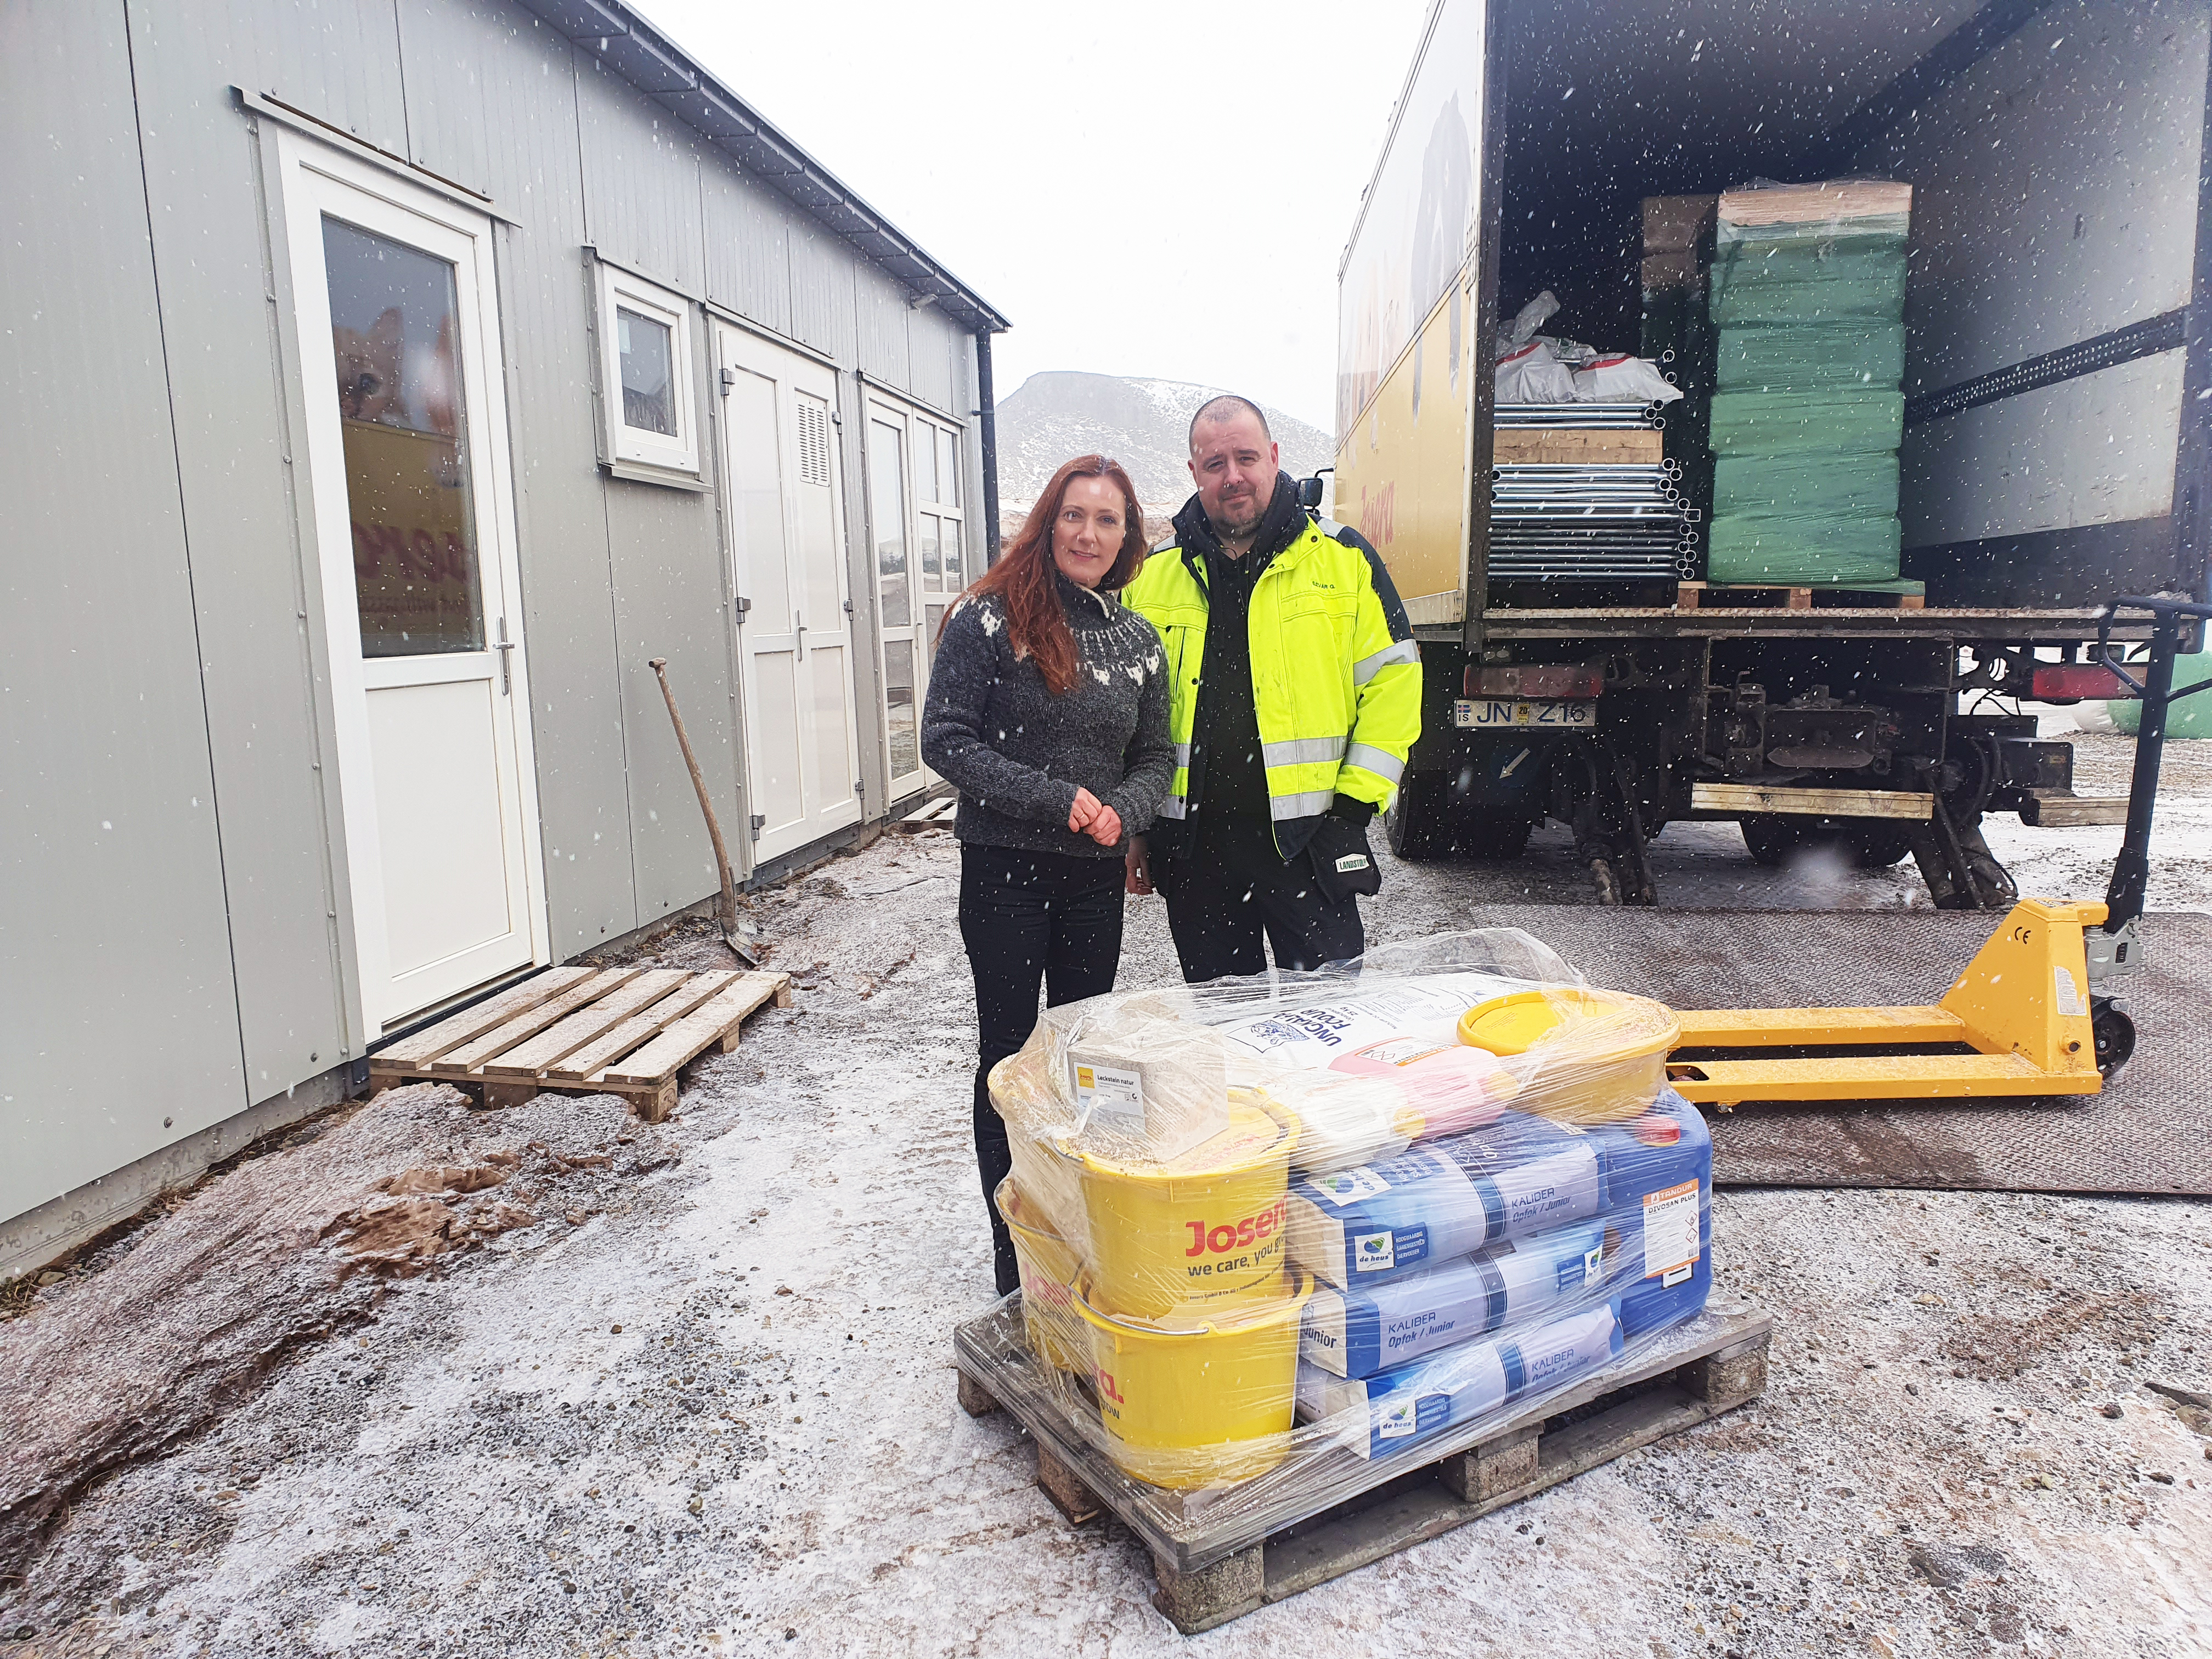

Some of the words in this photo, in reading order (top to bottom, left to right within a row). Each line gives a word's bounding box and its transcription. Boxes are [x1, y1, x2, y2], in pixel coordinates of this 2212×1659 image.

[1458, 714, 1469, 722] IS
[1477, 702, 1512, 723] JN
[1537, 702, 1585, 723] Z16
[1097, 1075, 1120, 1084] Leckstein
[1660, 1183, 1692, 1199] TANDUR
[1648, 1199, 1679, 1214] DIVOSAN
[1680, 1193, 1696, 1203] PLUS
[1188, 1265, 1212, 1277] we
[1217, 1256, 1250, 1273] care,
[1254, 1243, 1273, 1266] you
[1388, 1311, 1436, 1334] KALIBER
[1388, 1330, 1417, 1348] Opfok
[1418, 1327, 1424, 1339] /
[1425, 1320, 1455, 1337] Junior
[1532, 1348, 1574, 1372] KALIBER
